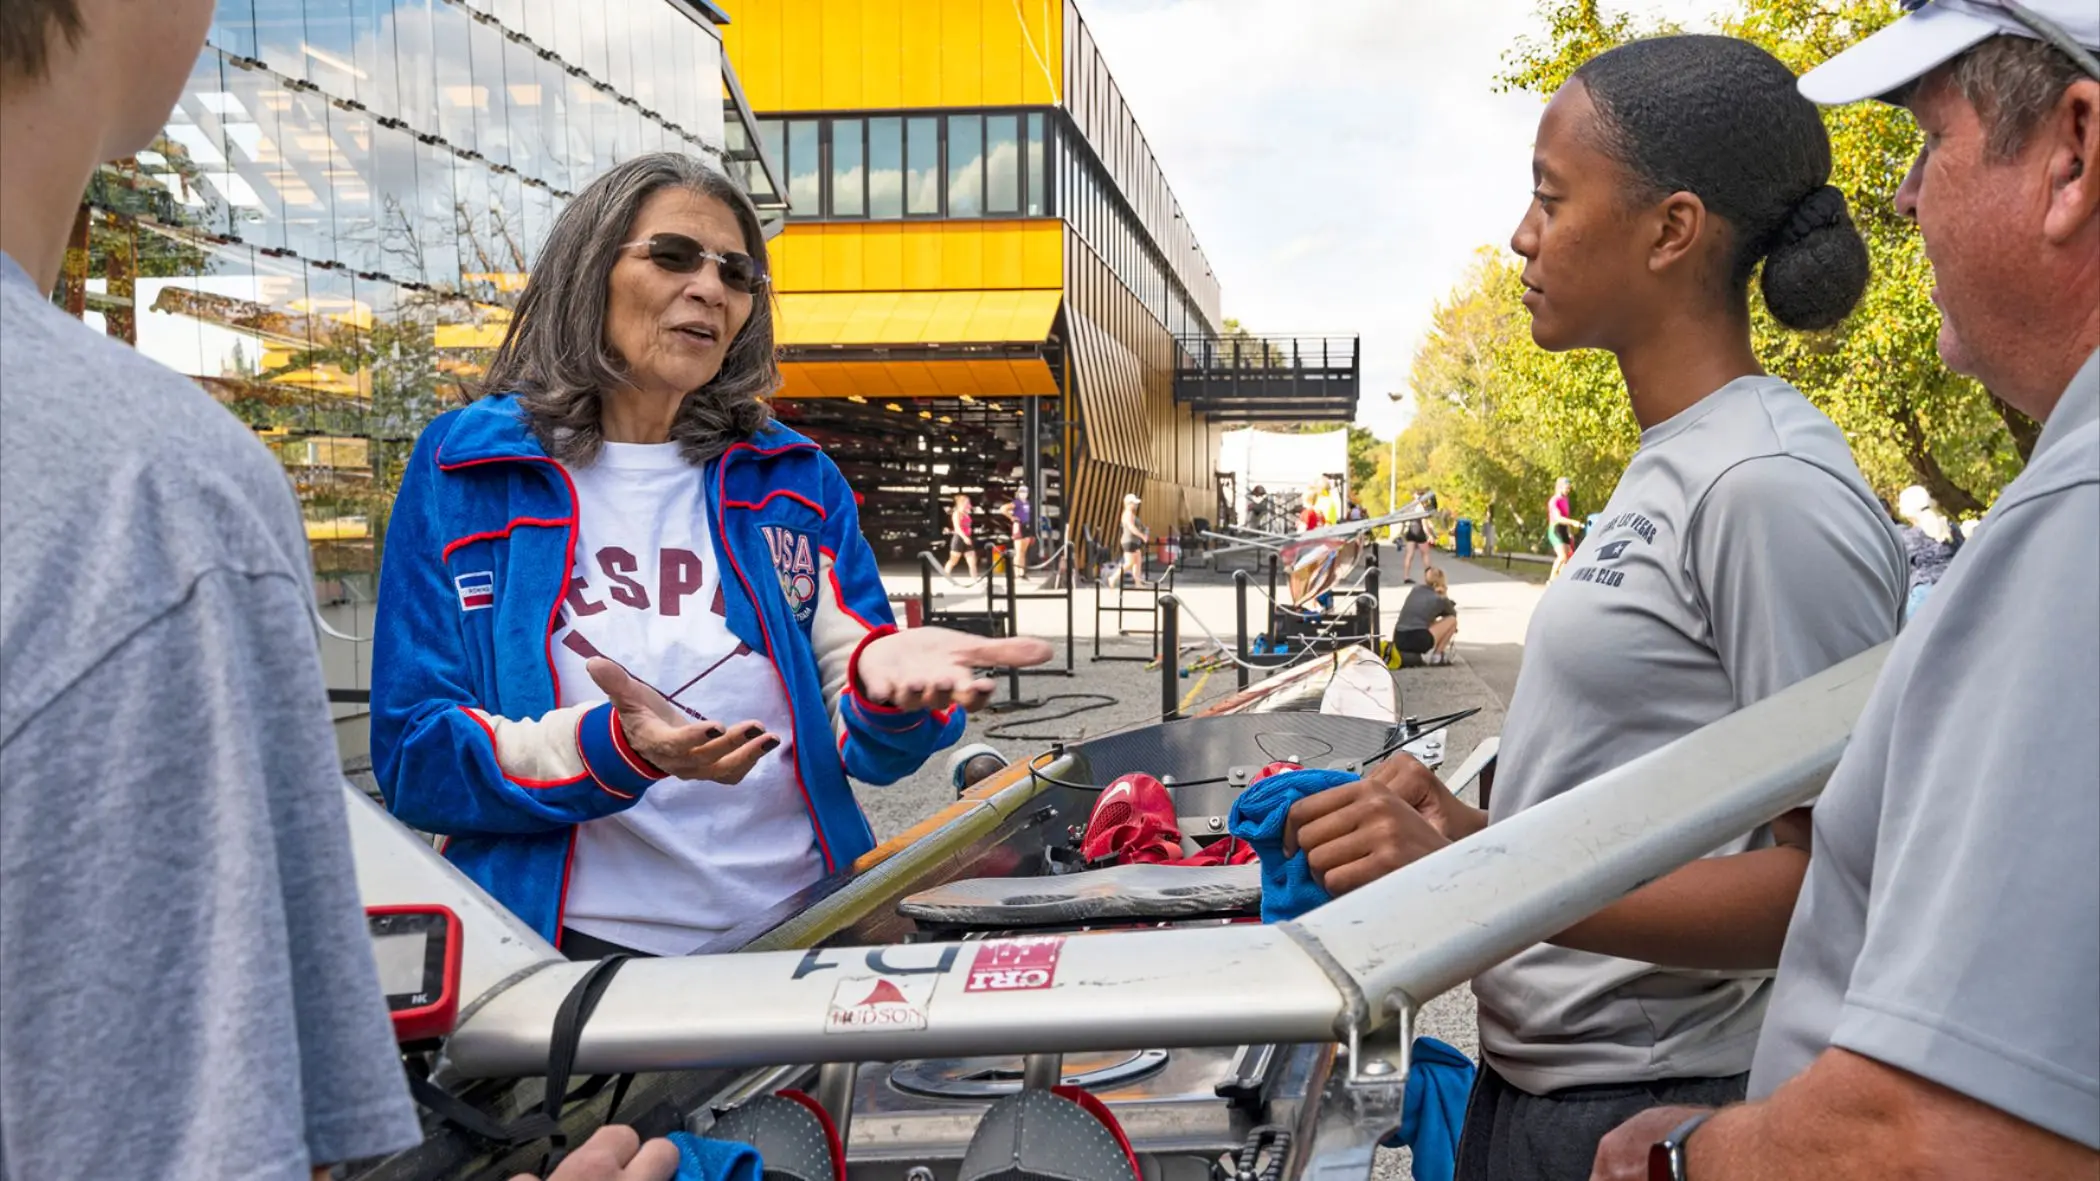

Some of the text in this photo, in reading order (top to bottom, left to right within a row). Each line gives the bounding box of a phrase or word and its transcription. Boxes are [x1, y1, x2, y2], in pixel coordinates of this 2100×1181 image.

[1630, 514, 1656, 545] VEGAS
[760, 526, 816, 575] USA
[1595, 567, 1625, 587] CLUB
[552, 546, 727, 635] ESP
[968, 969, 1049, 989] CRI
[831, 1006, 923, 1026] HUDSON
